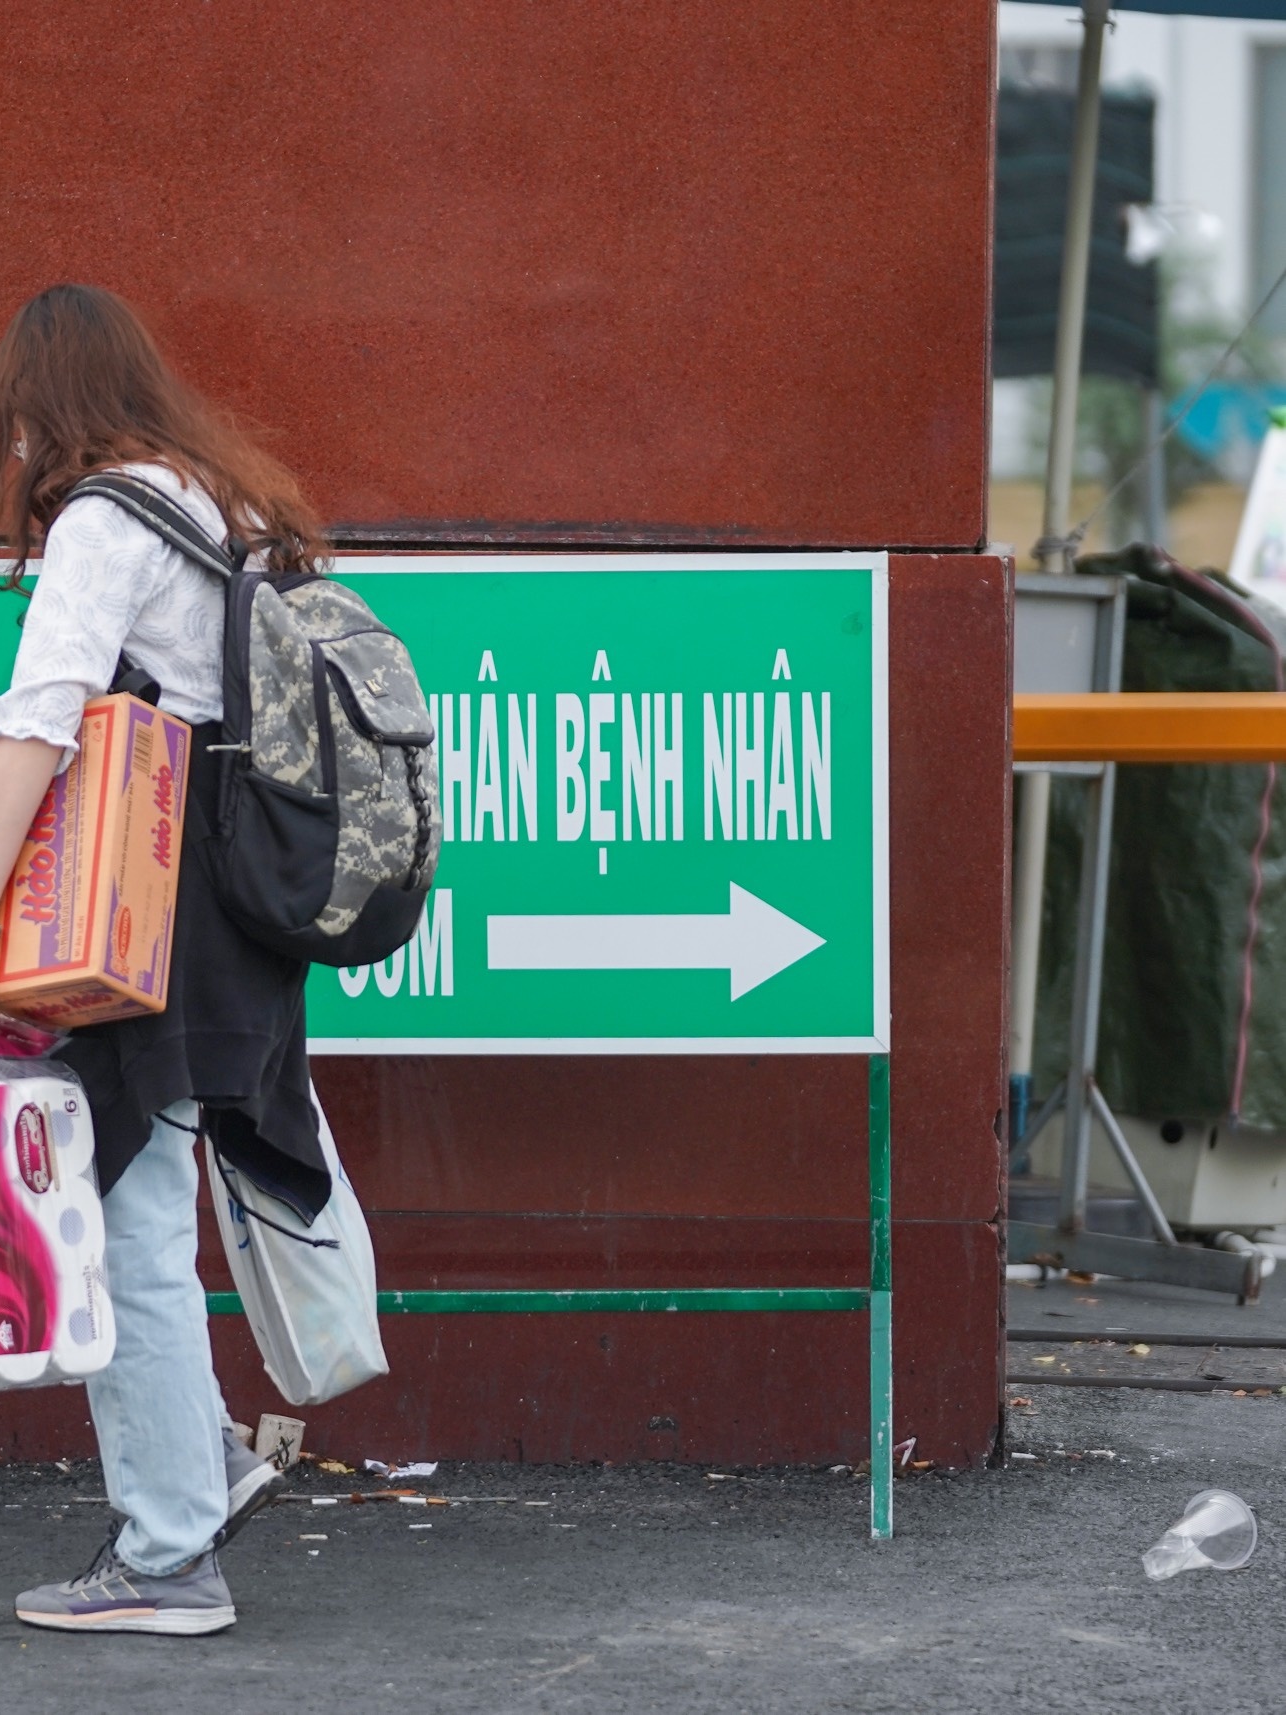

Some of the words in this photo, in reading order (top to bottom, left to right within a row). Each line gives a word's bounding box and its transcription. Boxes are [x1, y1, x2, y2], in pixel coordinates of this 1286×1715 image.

[555, 649, 684, 875] BỆNH
[703, 648, 832, 842] NHÂN
[16, 846, 58, 926] Hảo
